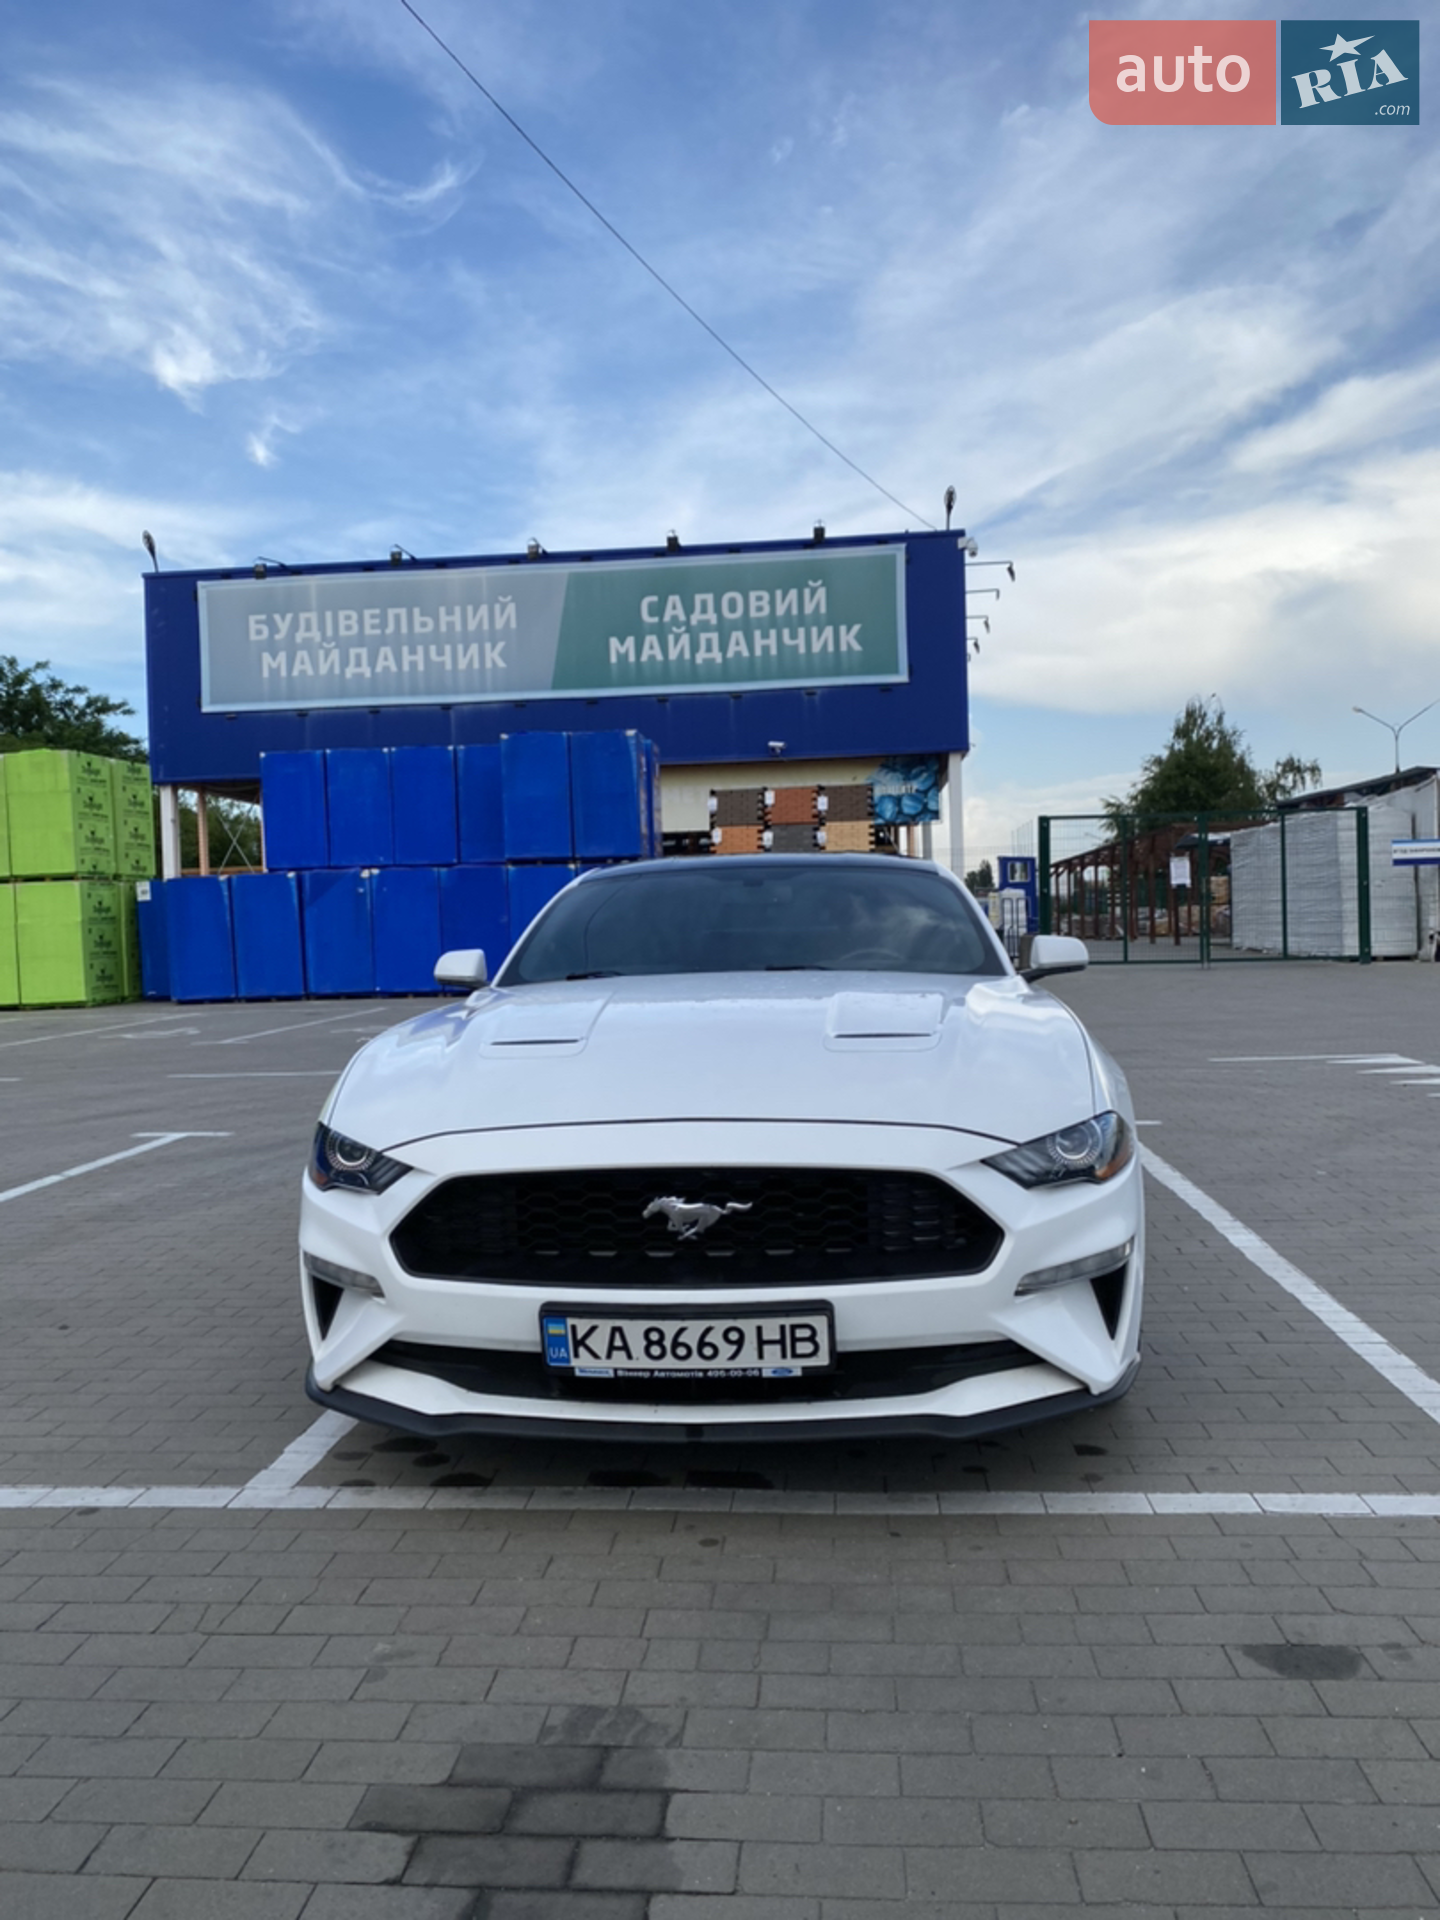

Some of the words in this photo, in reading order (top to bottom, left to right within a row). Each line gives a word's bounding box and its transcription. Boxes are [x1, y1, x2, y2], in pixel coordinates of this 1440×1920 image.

[248, 595, 518, 643] БУДІВЕЛЬНИЙ
[639, 579, 828, 626] САДОВИЙ
[260, 641, 508, 679] МАЙДАНЧИК
[608, 624, 863, 664] МАЙДАНЧИК
[550, 1346, 568, 1360] UA
[569, 1323, 634, 1361] KA
[643, 1325, 746, 1362] 8669
[756, 1323, 821, 1360] HB
